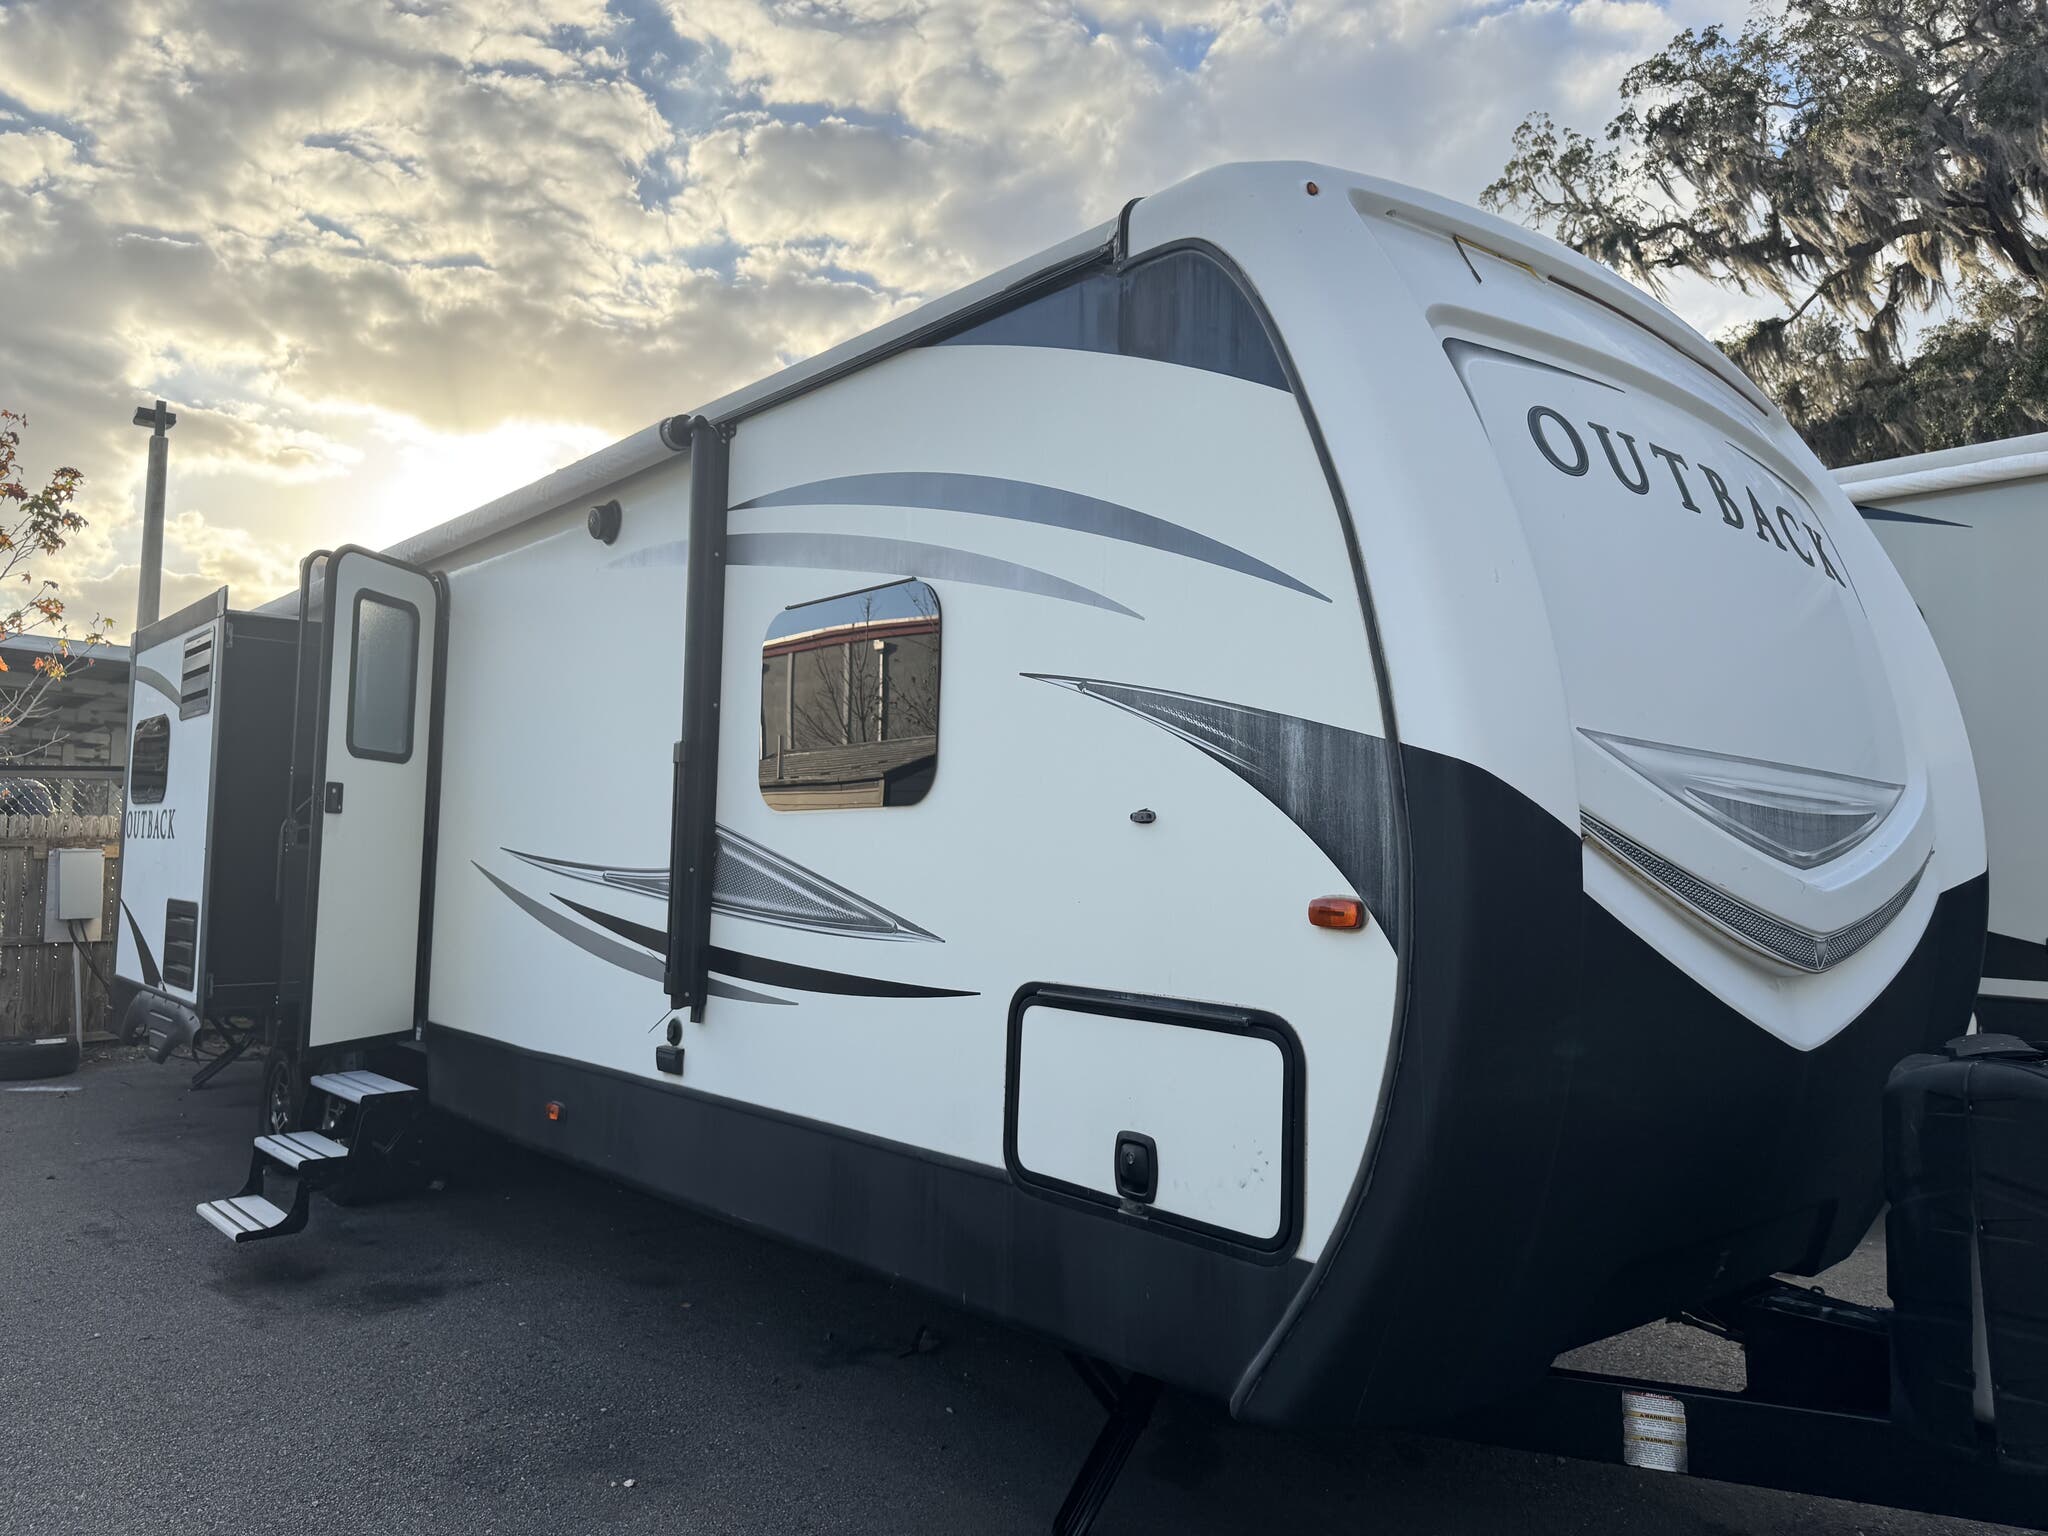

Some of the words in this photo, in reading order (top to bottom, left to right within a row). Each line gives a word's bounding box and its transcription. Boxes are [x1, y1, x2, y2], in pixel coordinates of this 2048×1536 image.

[1527, 405, 1847, 588] OUTBACK
[126, 809, 175, 839] OUTBACK
[1645, 1413, 1672, 1422] WARNING
[1645, 1436, 1673, 1446] WARNING
